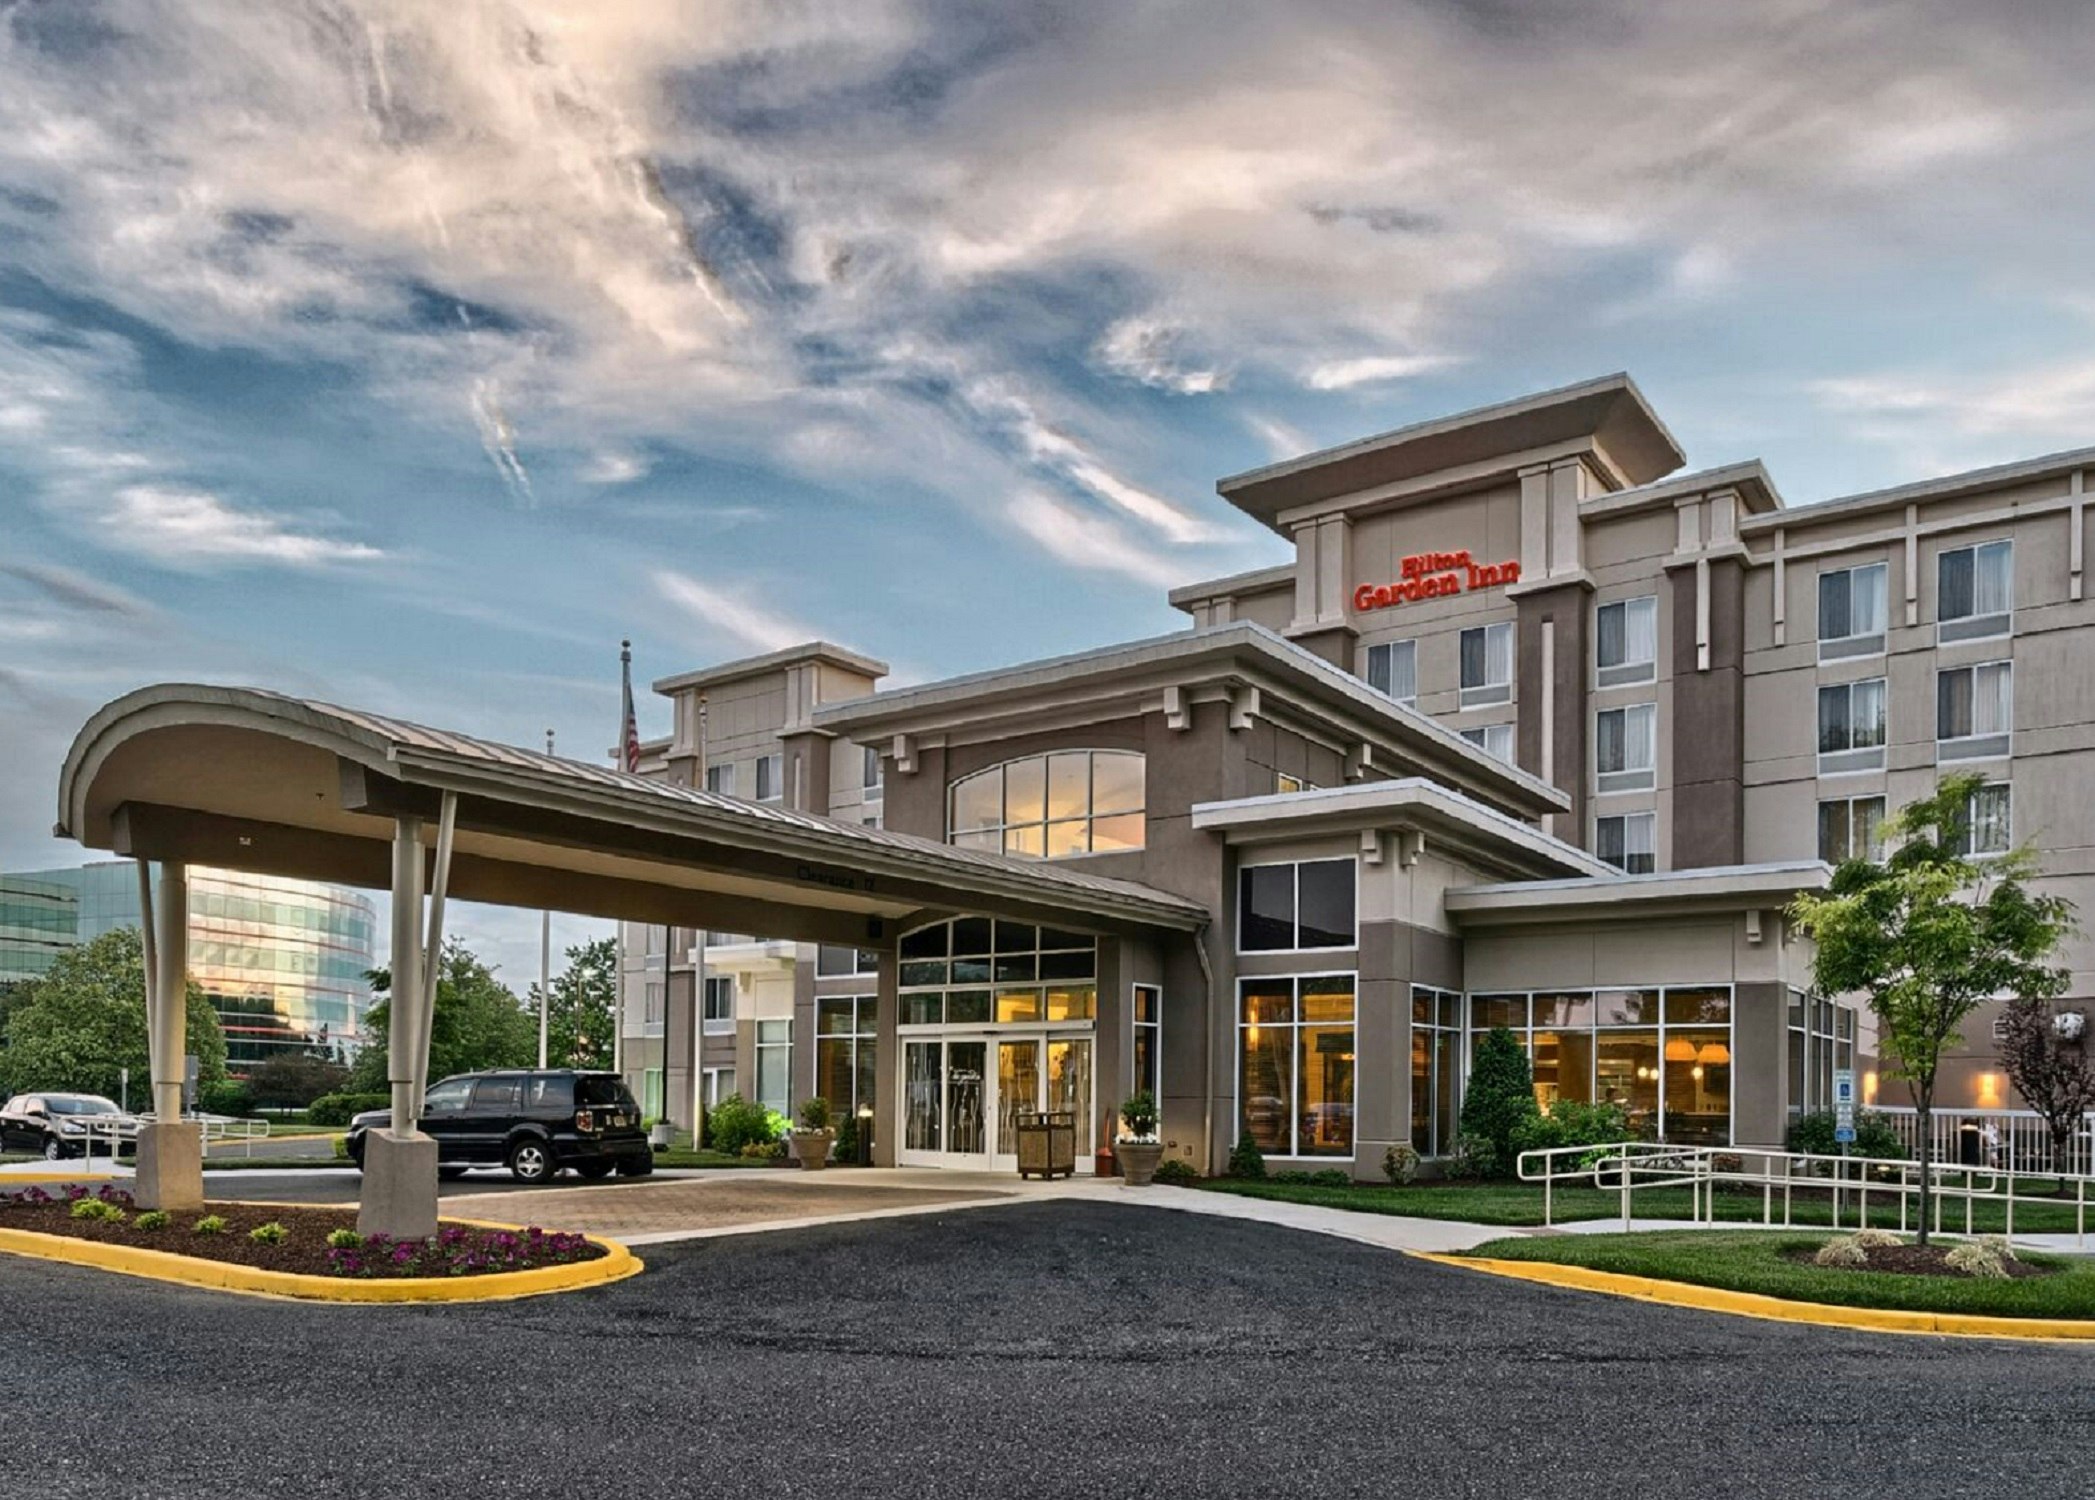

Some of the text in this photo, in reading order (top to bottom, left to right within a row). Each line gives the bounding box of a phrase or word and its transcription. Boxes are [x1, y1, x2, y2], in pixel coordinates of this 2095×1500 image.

[1402, 550, 1470, 578] Hilton
[1354, 561, 1520, 611] Garden Inn
